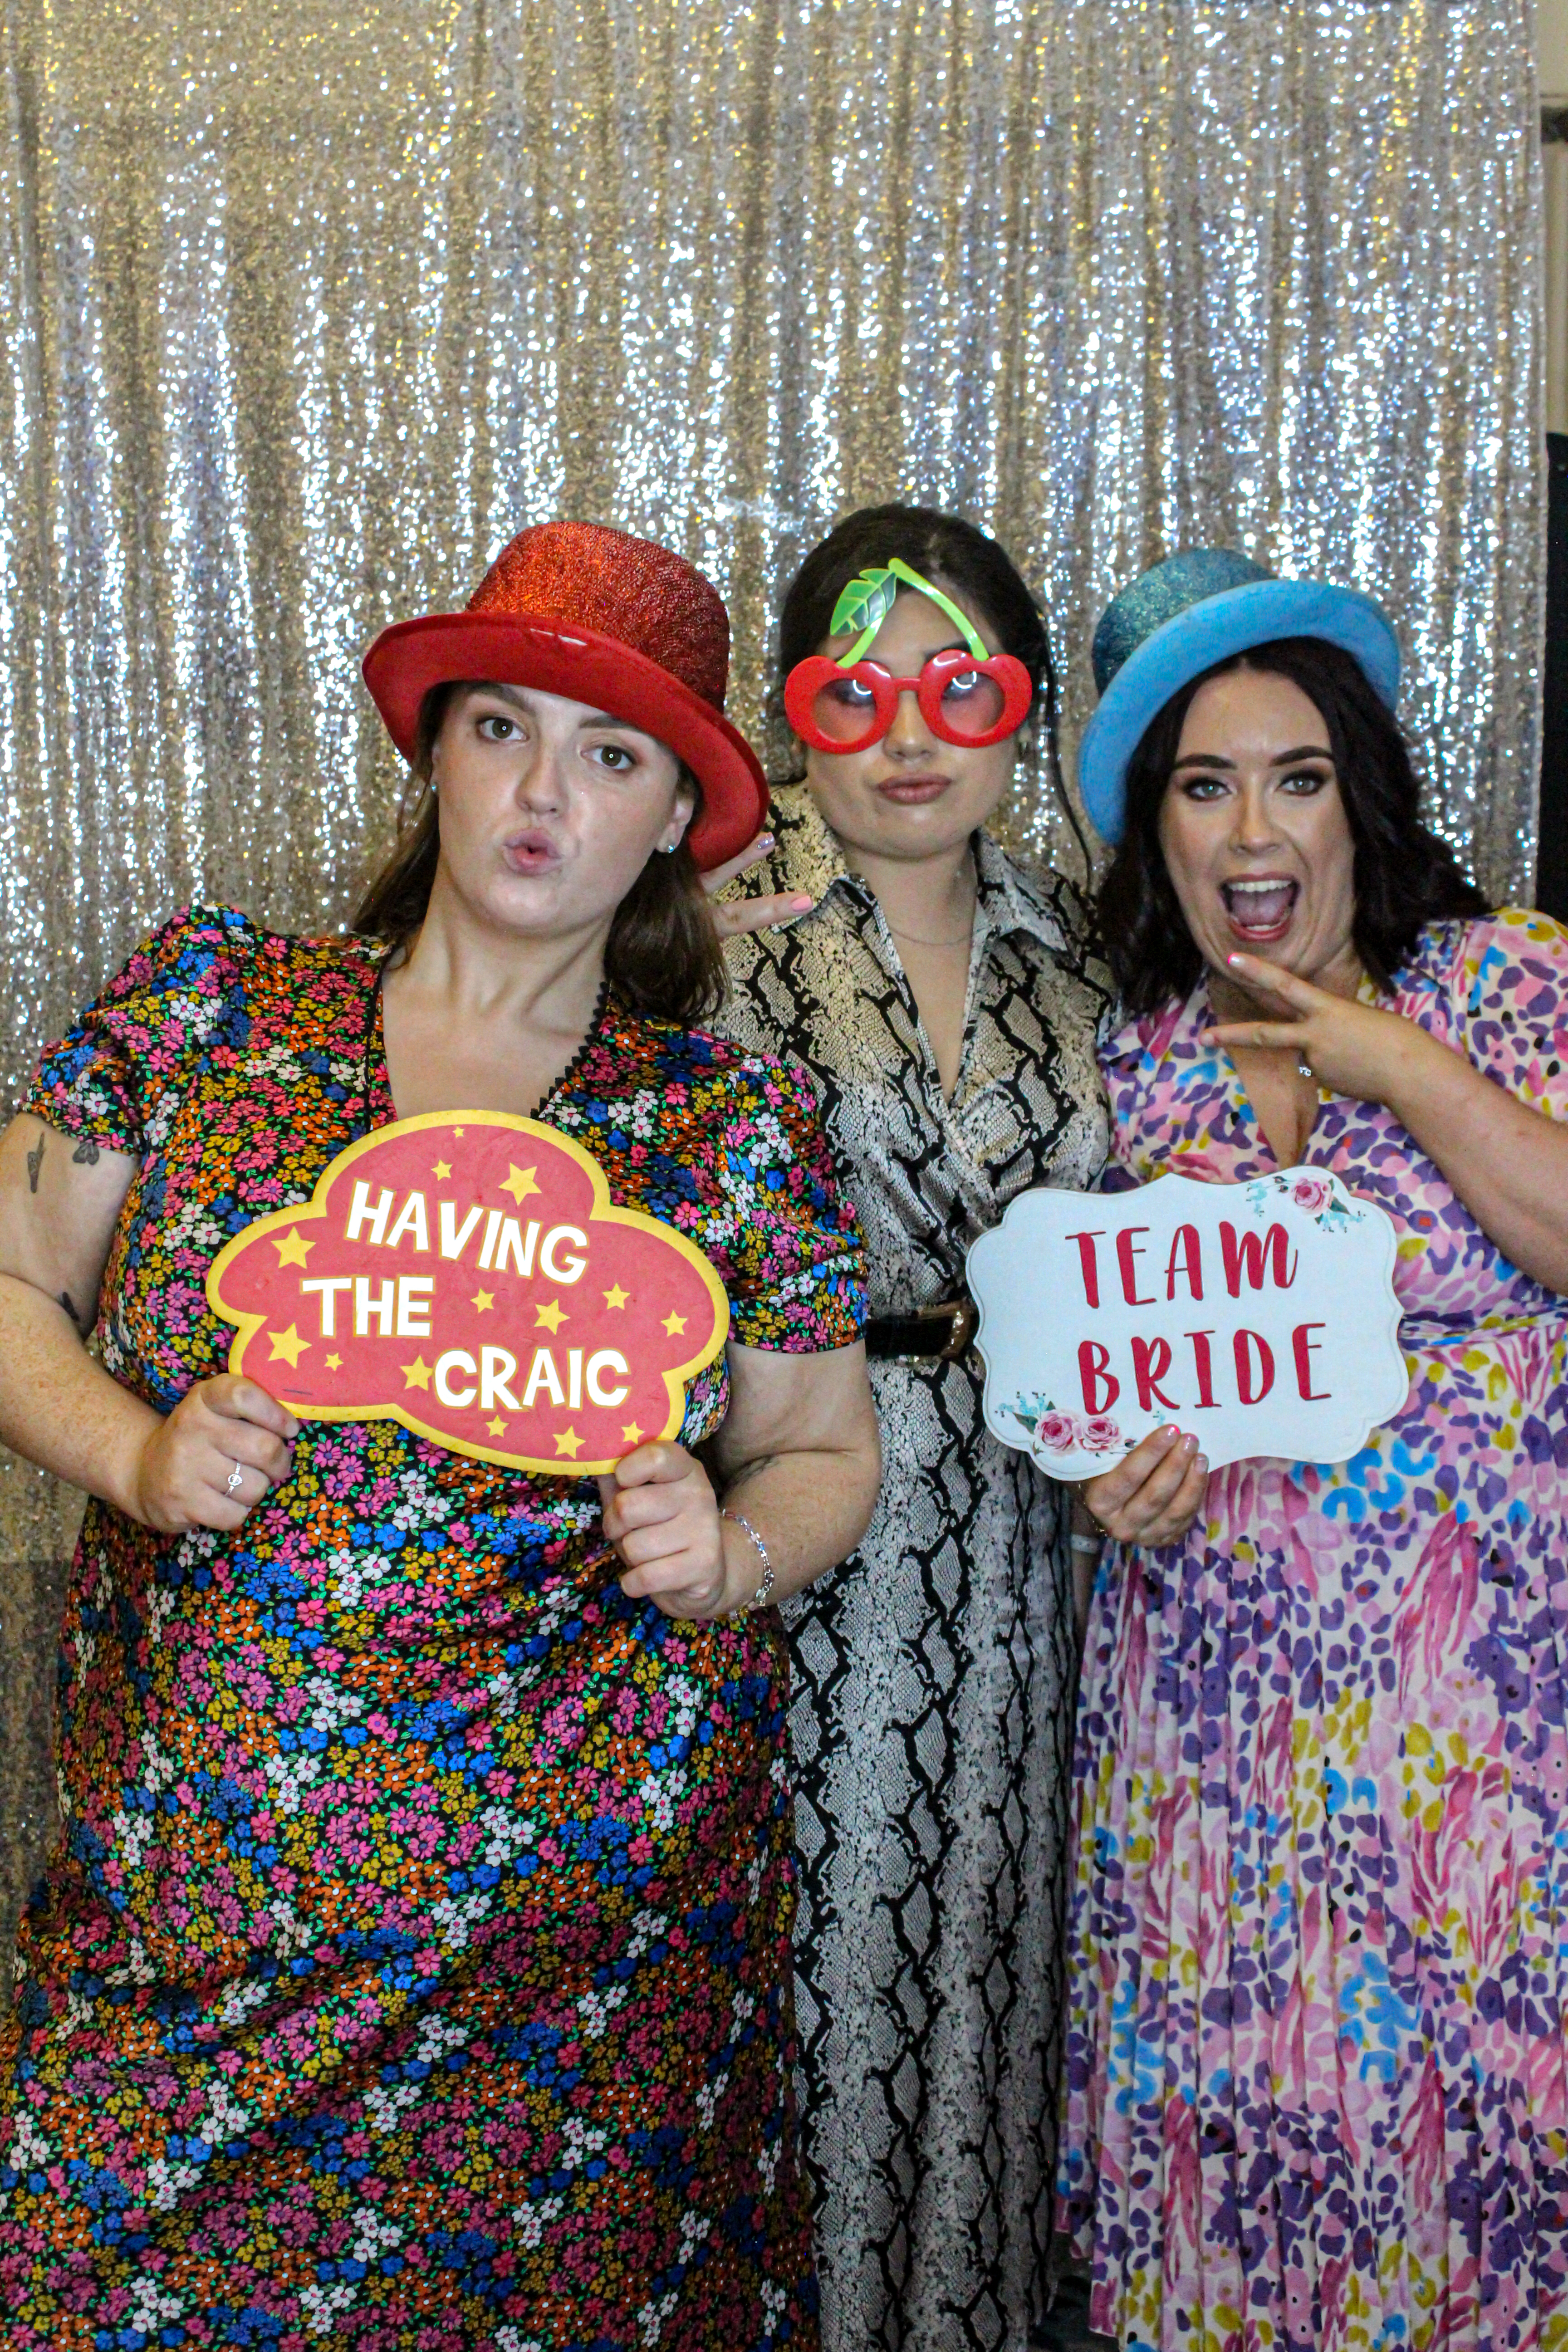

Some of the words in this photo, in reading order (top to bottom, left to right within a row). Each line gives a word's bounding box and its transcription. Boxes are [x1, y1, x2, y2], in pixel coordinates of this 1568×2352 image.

[344, 1180, 588, 1285] HAVING
[1065, 1220, 1298, 1309] TEAM
[300, 1275, 435, 1338] THE
[434, 1346, 631, 1410] CRAIC
[1077, 1323, 1332, 1415] BRIDE
